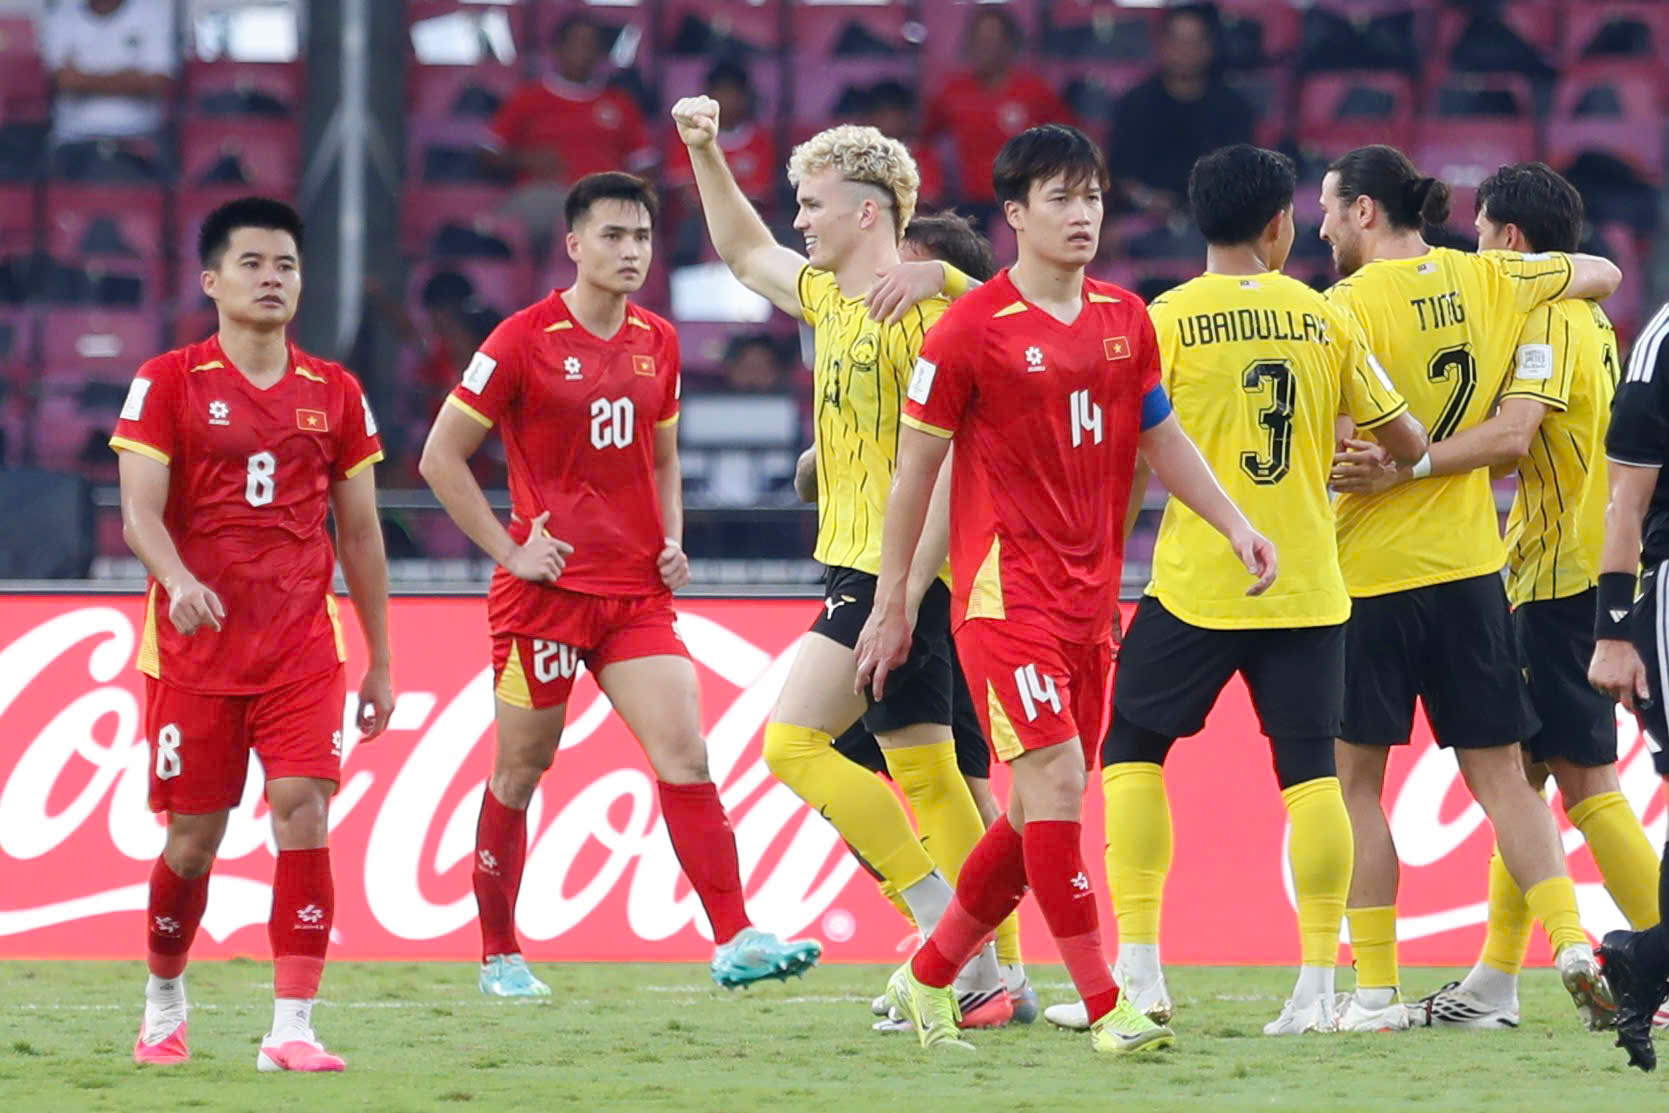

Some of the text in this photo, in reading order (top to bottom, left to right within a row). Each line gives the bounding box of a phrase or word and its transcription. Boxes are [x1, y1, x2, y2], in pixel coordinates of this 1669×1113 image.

[1069, 388, 1103, 448] 14
[1240, 358, 1295, 485] 3
[1428, 342, 1477, 443] 2
[590, 396, 634, 450] 20
[245, 451, 276, 508] 8
[532, 639, 577, 684] 20
[1014, 663, 1062, 723] 14
[156, 723, 181, 781] 8
